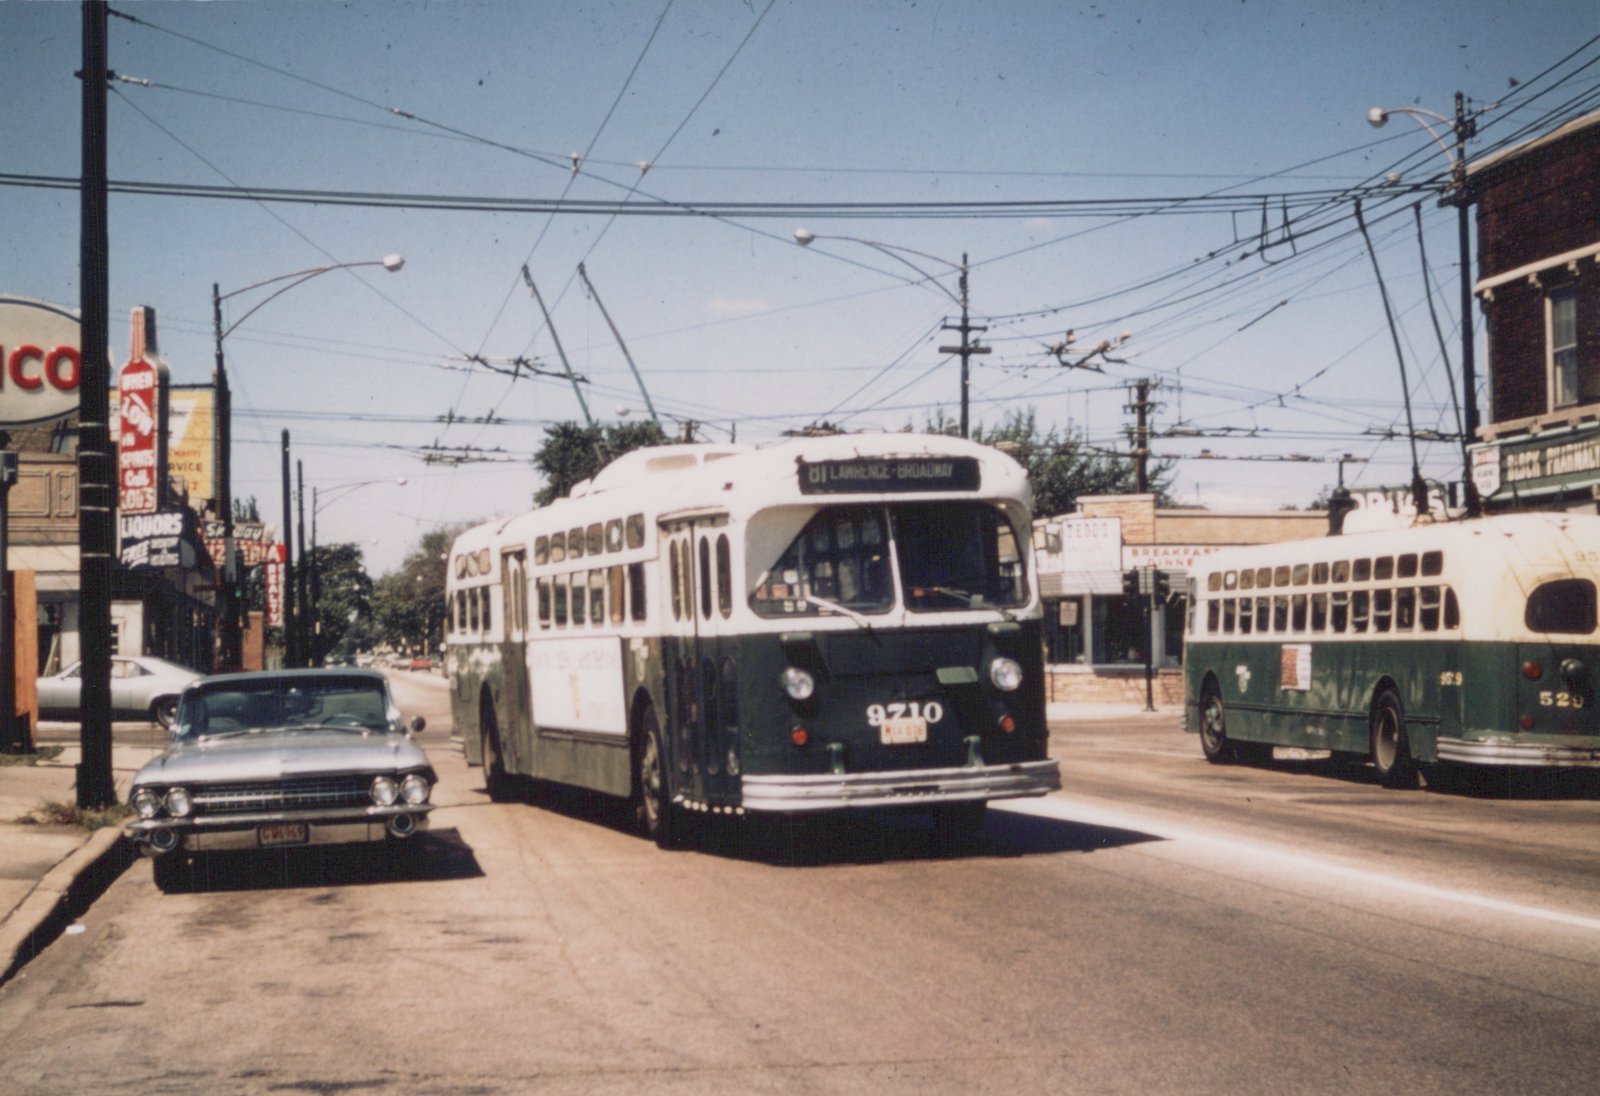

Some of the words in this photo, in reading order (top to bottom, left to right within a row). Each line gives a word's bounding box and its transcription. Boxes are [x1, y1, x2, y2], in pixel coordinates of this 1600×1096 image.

[0, 345, 81, 391] CO
[168, 462, 203, 472] RVICE
[808, 465, 827, 483] 81
[121, 512, 182, 539] LIQUORS
[1147, 558, 1195, 568] DINNE
[268, 563, 280, 625] REALTY
[866, 701, 943, 727] 9710
